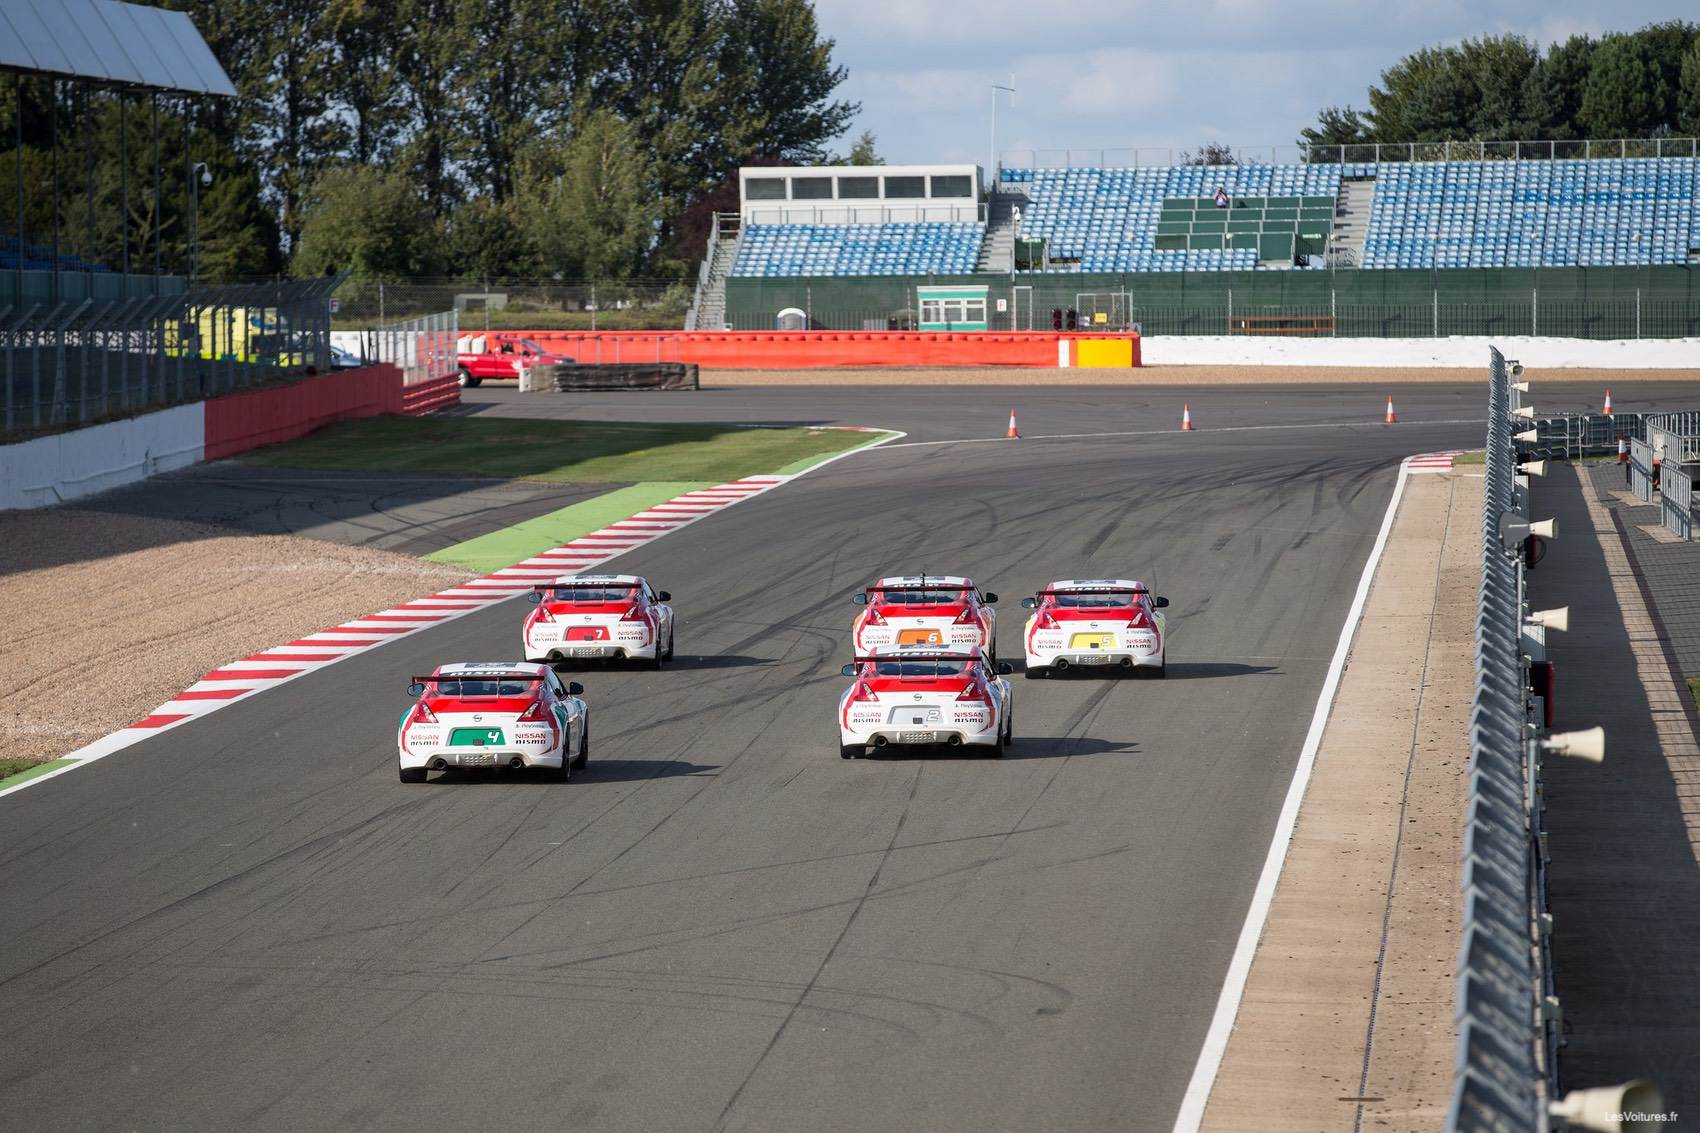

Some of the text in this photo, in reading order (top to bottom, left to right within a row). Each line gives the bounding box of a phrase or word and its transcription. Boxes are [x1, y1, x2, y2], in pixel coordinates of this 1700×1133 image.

[595, 629, 604, 639] 7
[928, 632, 939, 642] 6
[926, 709, 941, 721] 2
[487, 731, 500, 743] 4
